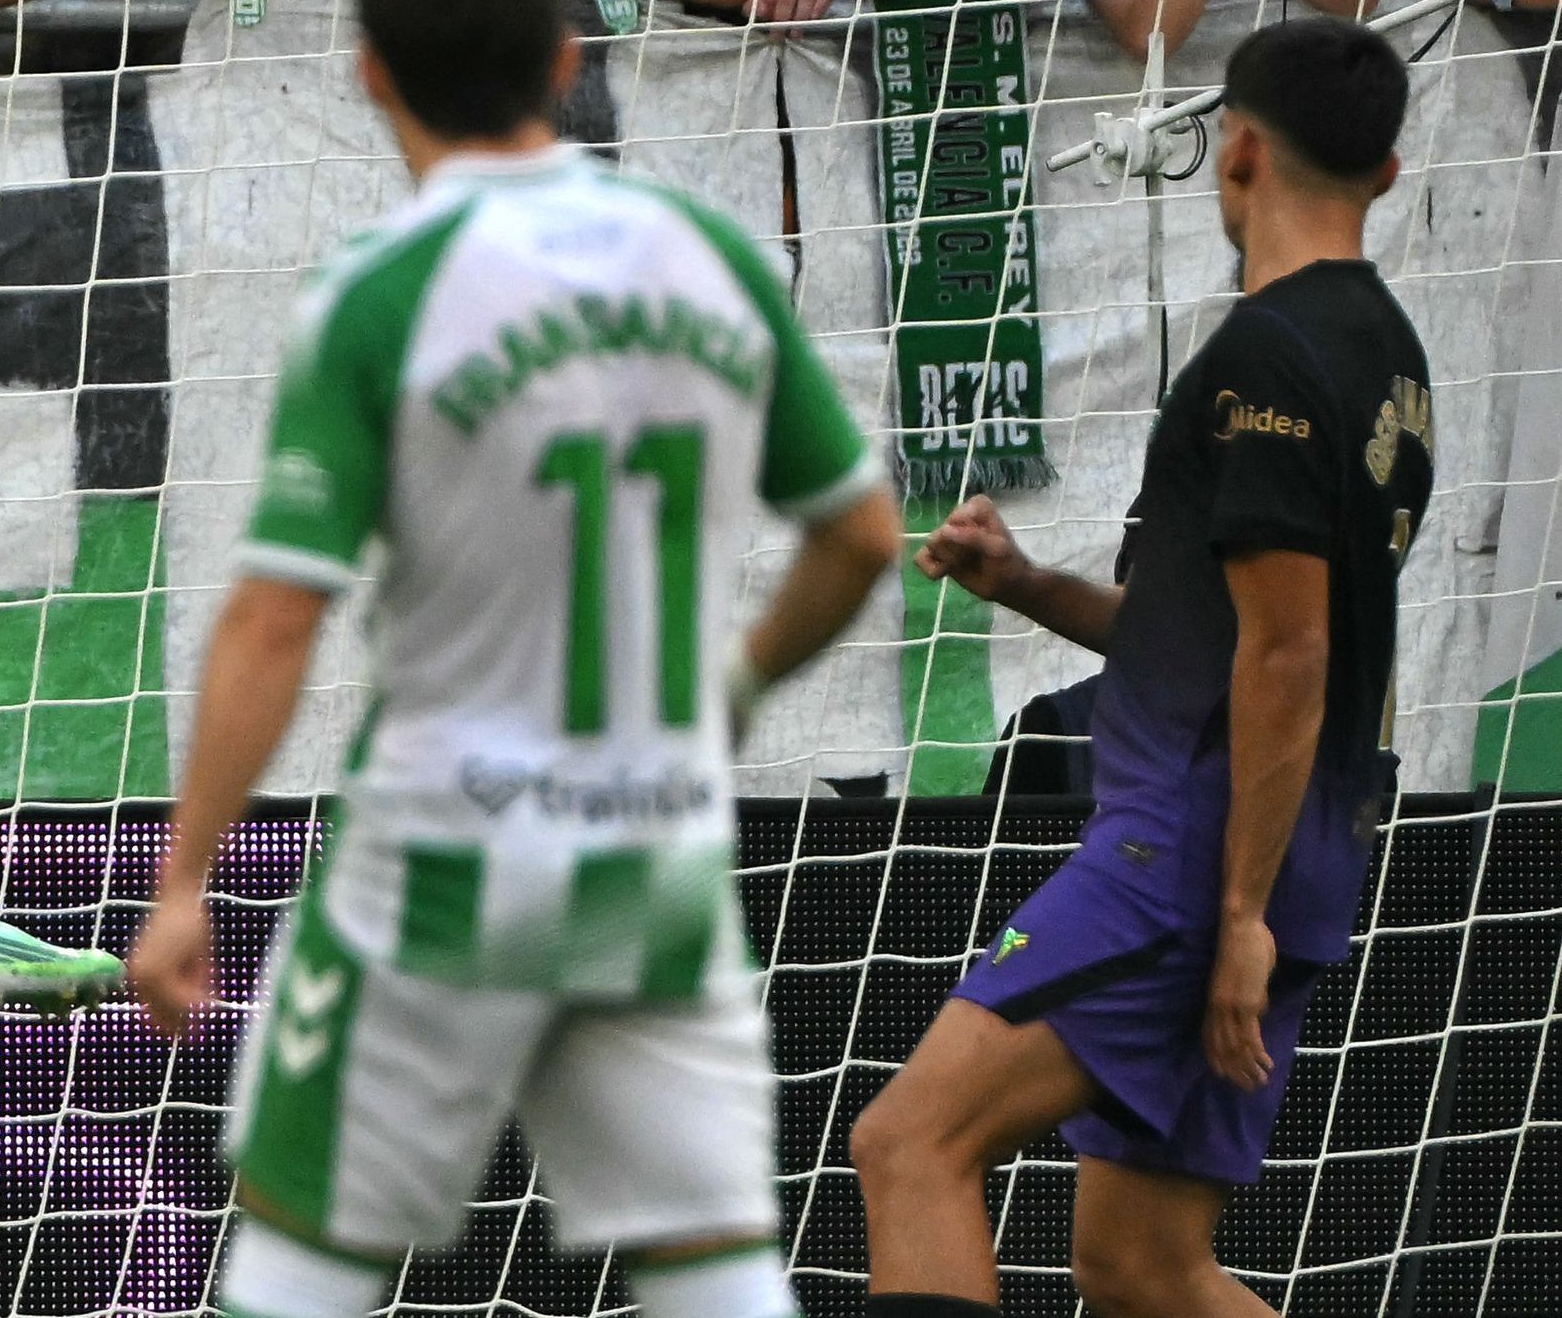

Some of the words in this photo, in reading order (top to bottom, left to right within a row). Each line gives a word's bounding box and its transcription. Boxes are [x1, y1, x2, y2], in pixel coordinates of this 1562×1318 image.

[889, 64, 913, 93] DE
[891, 98, 919, 167] ABRIL
[893, 171, 919, 200] DE
[918, 359, 1031, 451] BETIS
[533, 418, 709, 736] 11
